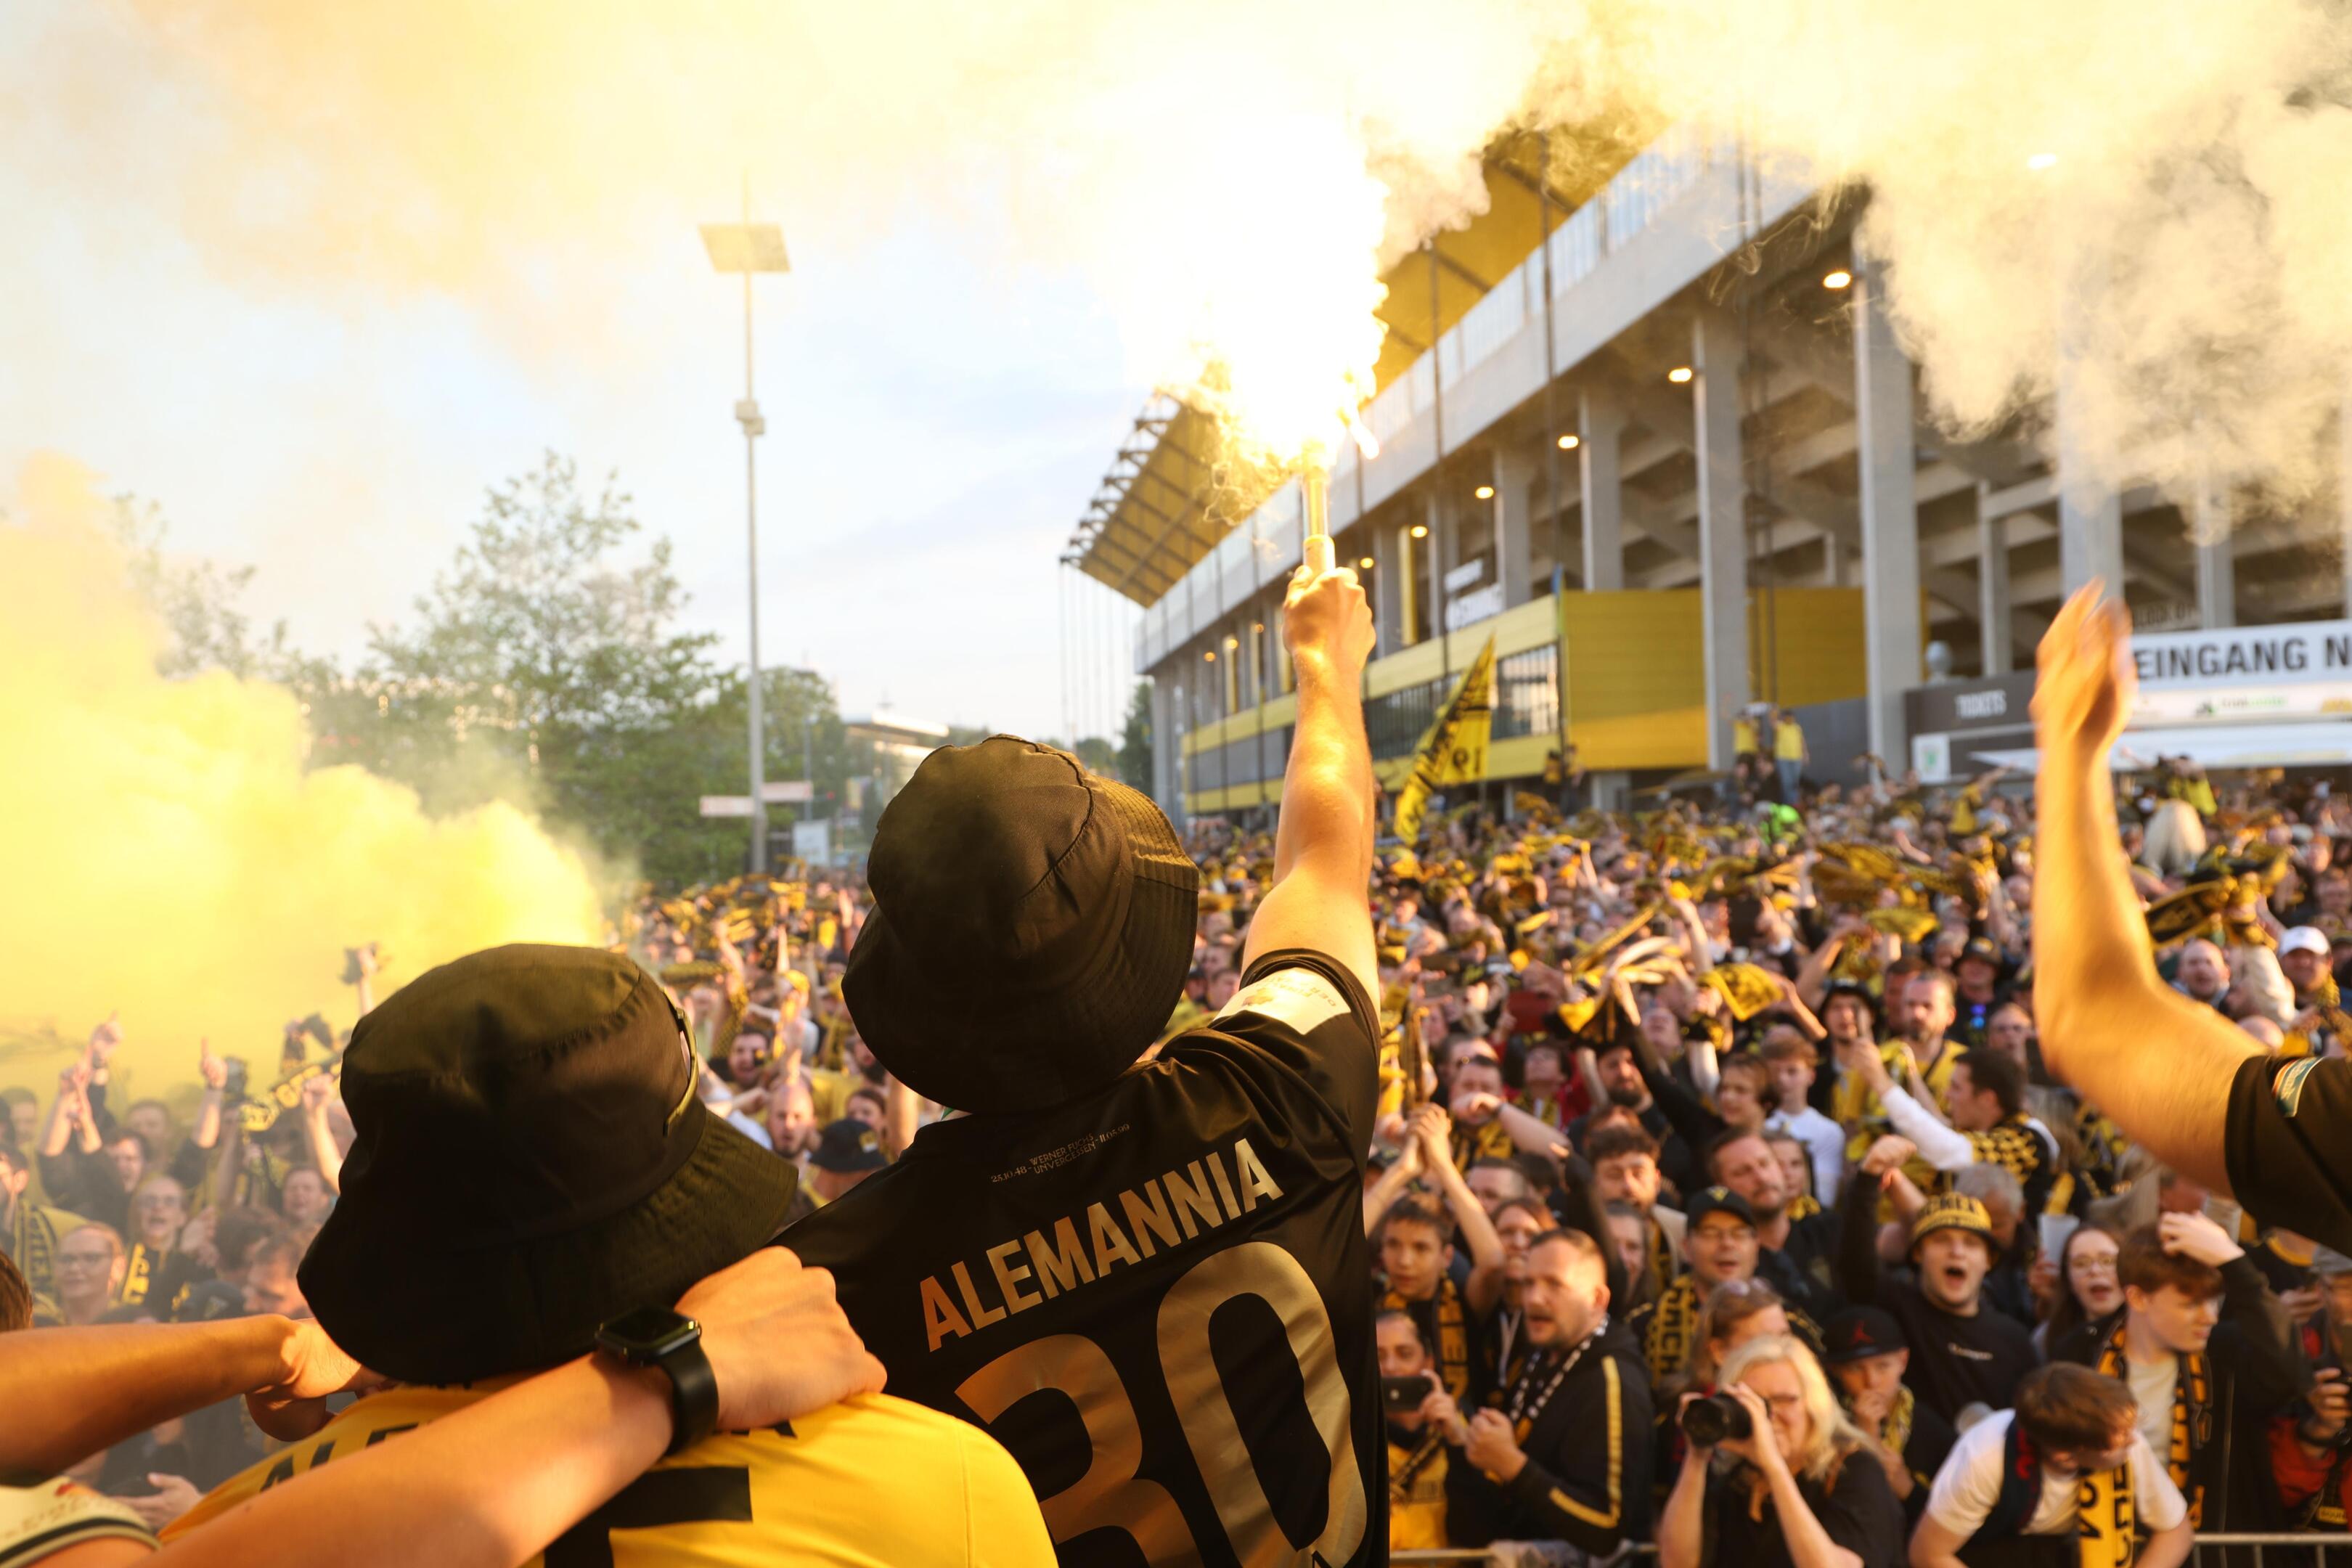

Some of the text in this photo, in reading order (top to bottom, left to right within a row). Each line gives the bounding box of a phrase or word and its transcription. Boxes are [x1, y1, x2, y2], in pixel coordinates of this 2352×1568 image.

[2135, 637, 2308, 680] EINGANG
[1029, 1133, 1094, 1166] WERNER FUCHS
[1033, 1141, 1096, 1174] UNVERGESSEN
[920, 1138, 1284, 1352] ALEMANNIA
